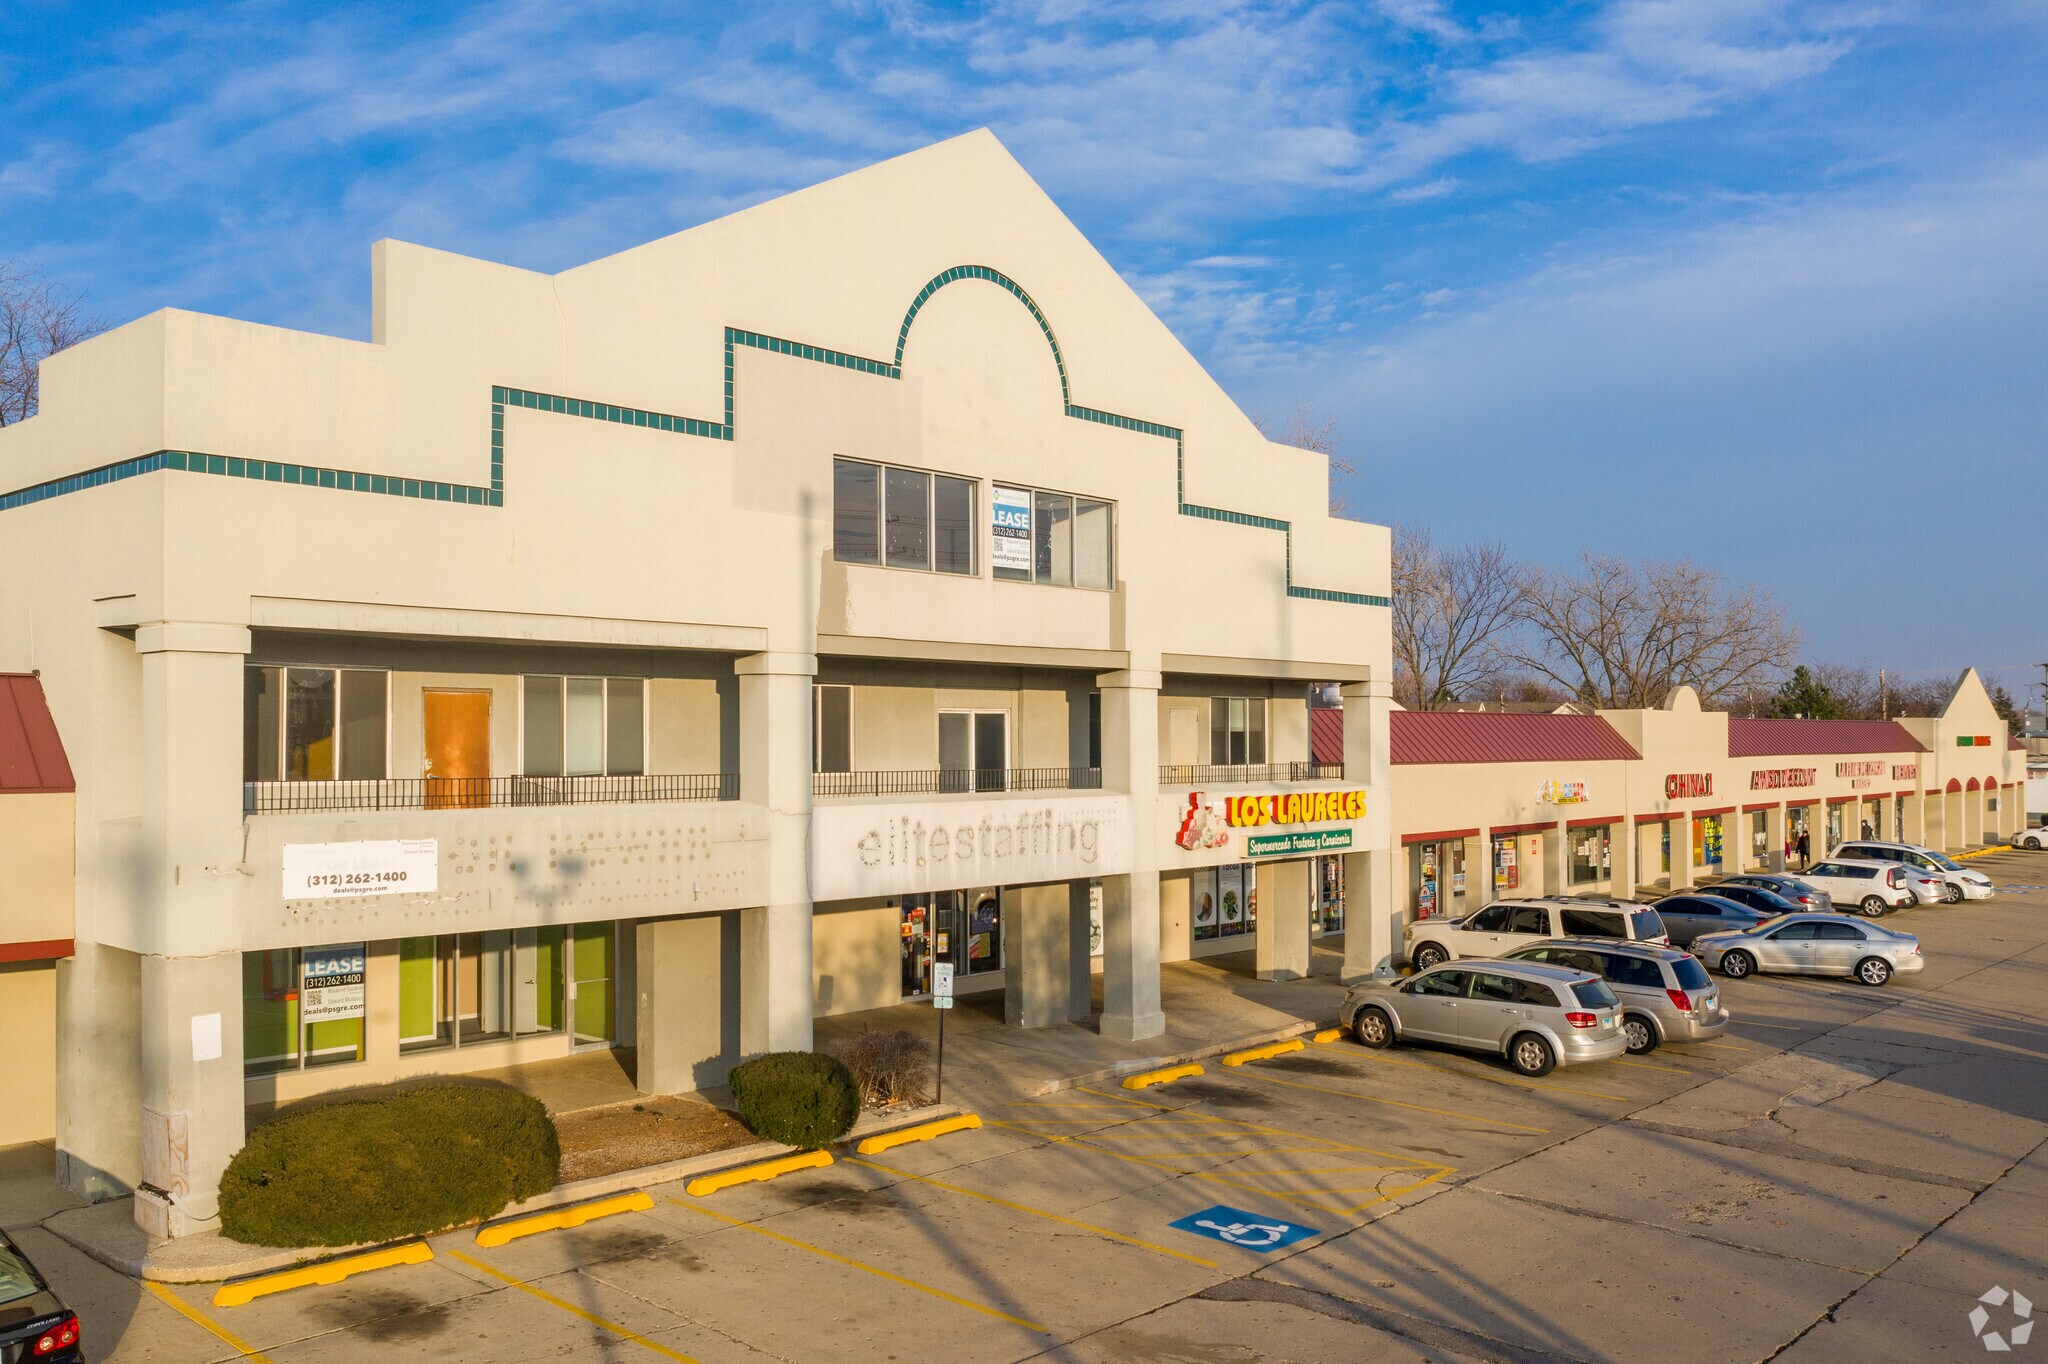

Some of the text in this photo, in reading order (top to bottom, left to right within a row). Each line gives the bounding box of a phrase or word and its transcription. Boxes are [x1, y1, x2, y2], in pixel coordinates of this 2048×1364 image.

[993, 509, 1029, 528] LEASE
[993, 527, 1027, 539] (312) 262-1400
[1666, 773, 1706, 799] CHINA
[1781, 768, 1816, 788] DISCOUNT
[1226, 790, 1366, 827] LOS LAURELES
[1250, 837, 1291, 855] Supermercado
[307, 871, 407, 887] (312) 262-1400
[333, 886, 388, 894] deals@psgre.com
[305, 956, 363, 977] LEASE
[306, 974, 361, 989] (312) 262-1400
[304, 1003, 364, 1016] deals@psgre.com
